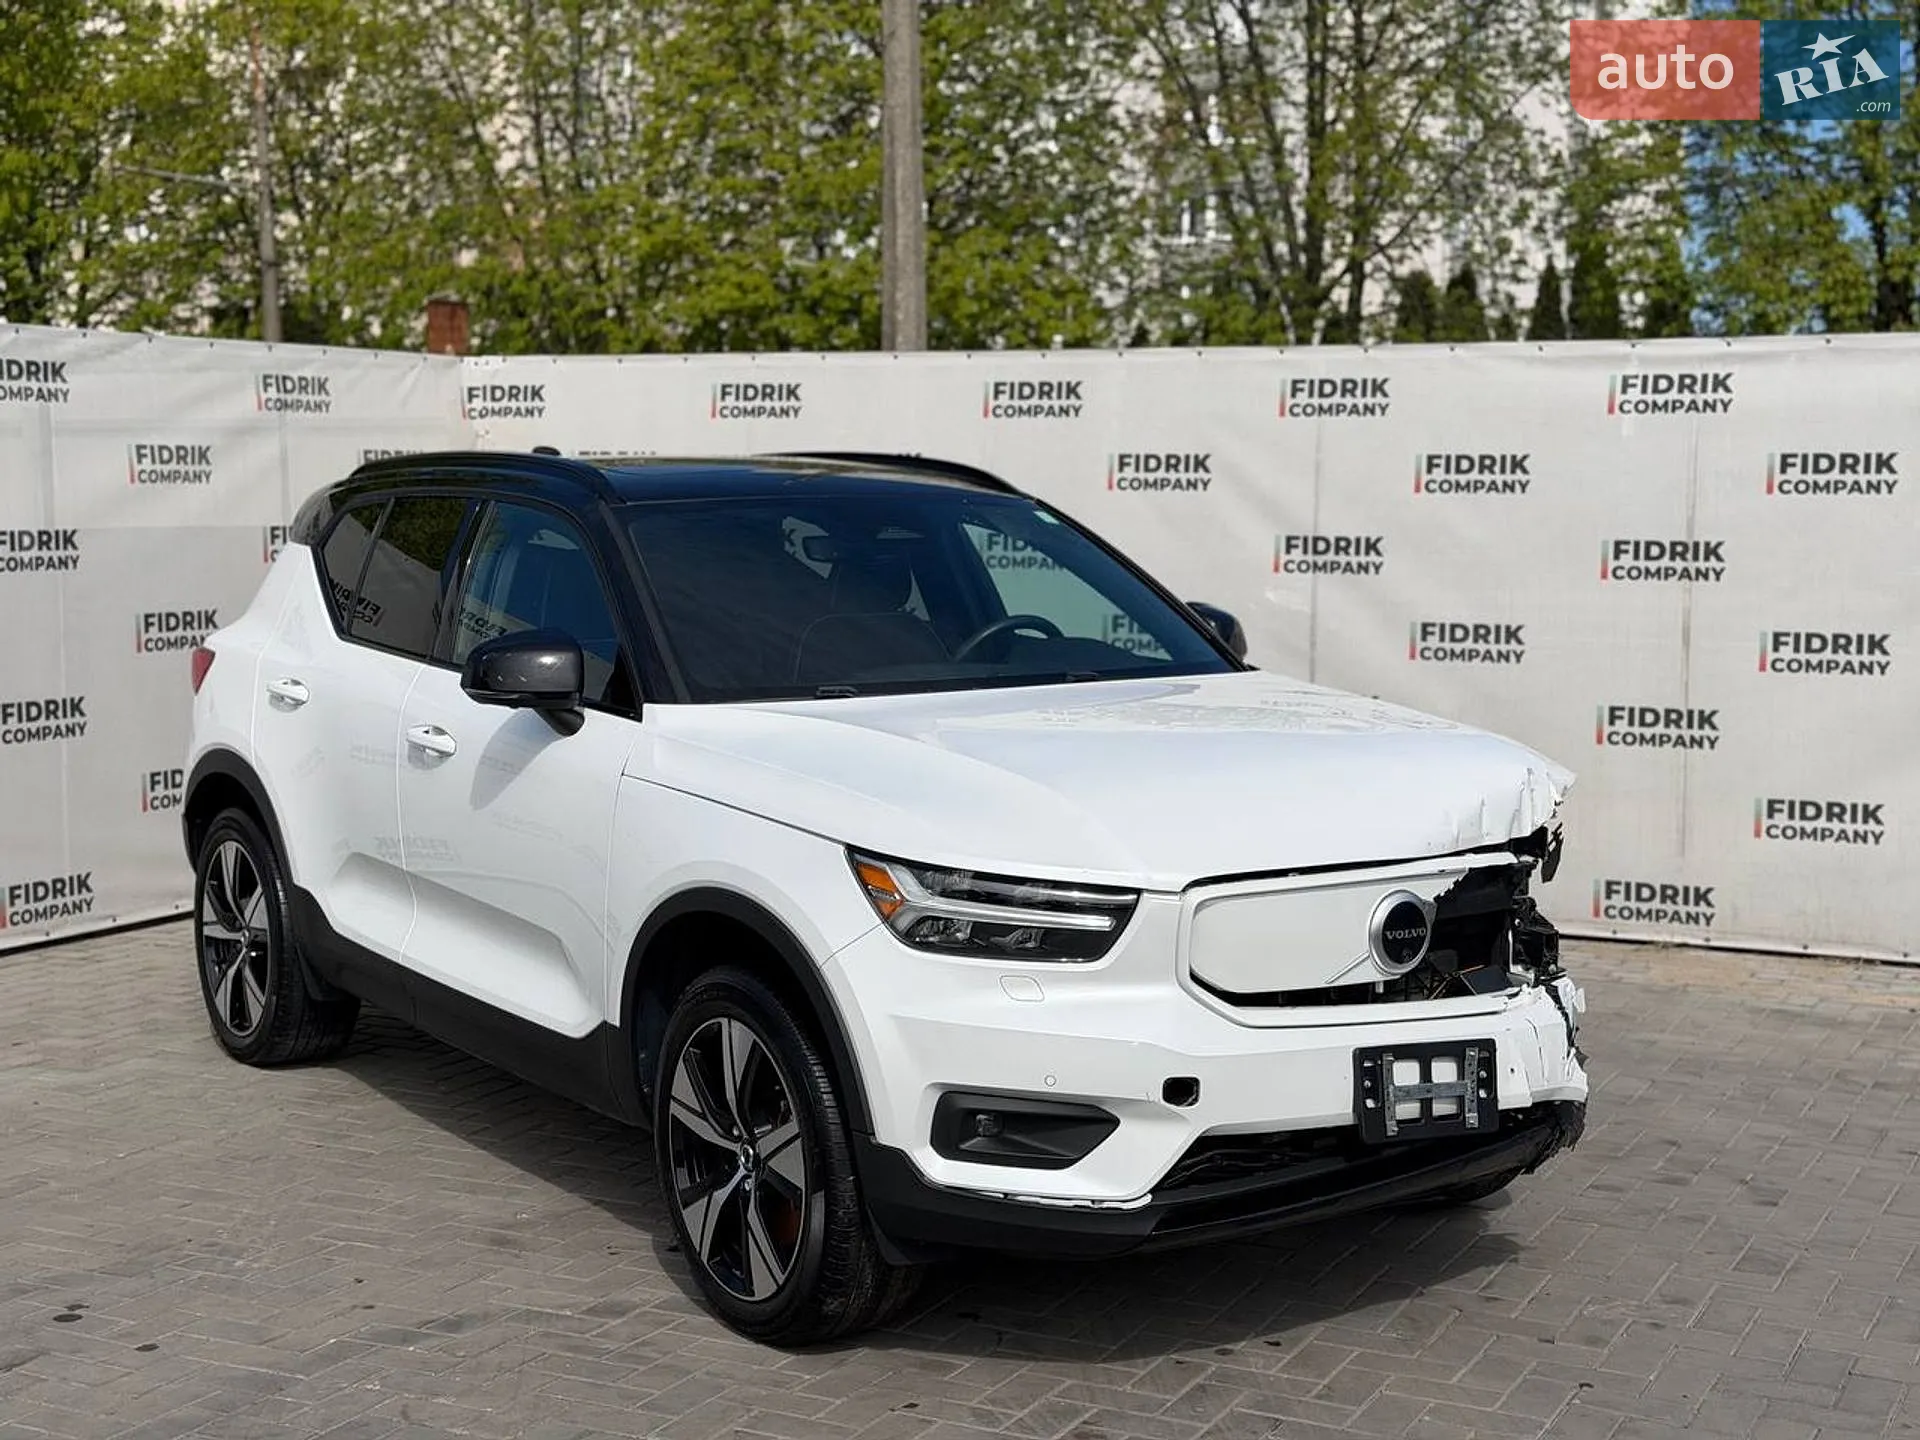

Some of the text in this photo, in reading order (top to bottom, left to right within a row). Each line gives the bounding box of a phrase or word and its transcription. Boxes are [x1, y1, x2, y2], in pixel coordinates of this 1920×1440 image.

[0, 358, 67, 383] IDRIK
[0, 385, 70, 403] OMPANY
[262, 374, 330, 396] FIDRIK
[467, 384, 545, 404] FIDRIK
[720, 383, 801, 402] FIDRIK
[993, 380, 1082, 401] FIDRIK
[1290, 377, 1389, 399] FIDRIK
[1620, 372, 1733, 395] FIDRIK
[264, 397, 330, 413] COMPANY
[467, 406, 545, 420] COMPANY
[719, 405, 801, 419] COMPANY
[991, 404, 1082, 418] COMPANY
[1288, 403, 1390, 417] COMPANY
[1618, 398, 1733, 415] COMPANY
[135, 444, 211, 466] FIDRIK
[1118, 453, 1211, 474] FIDRIK
[1426, 454, 1530, 475] FIDRIK
[1779, 452, 1898, 475] FIDRIK
[137, 468, 212, 484] COMPANY
[1116, 477, 1211, 491] COMPANY
[1424, 479, 1530, 494] COMPANY
[1777, 479, 1898, 495] COMPANY
[987, 532, 1028, 552] FID
[1285, 535, 1383, 557] FIDRIK
[1613, 539, 1725, 563] FIDRIK
[986, 555, 1062, 570] COMPA
[1283, 559, 1384, 575] COMPANY
[1611, 565, 1725, 582] COMPANY
[143, 609, 218, 634] FIDRIK
[143, 633, 206, 652] COMPA
[1420, 621, 1525, 646] FIDRIK
[1772, 631, 1890, 657] FIDRIK
[1419, 646, 1525, 664] COMPANY
[1770, 657, 1891, 676] COMPANY
[1, 696, 86, 726] FIDRIK
[1608, 705, 1719, 731] FIDRIK
[1, 721, 87, 745] COMPANY
[1606, 730, 1720, 750] COMPANY
[150, 768, 184, 793] FID
[1766, 798, 1884, 826] FIDRIK
[1765, 823, 1884, 845] COMPANY
[8, 871, 93, 908] FIDRIK
[1604, 879, 1715, 909] FIDRIK
[9, 896, 94, 927] COMPANY
[1603, 904, 1715, 927] COMPANY
[1384, 926, 1427, 940] VOLVO
